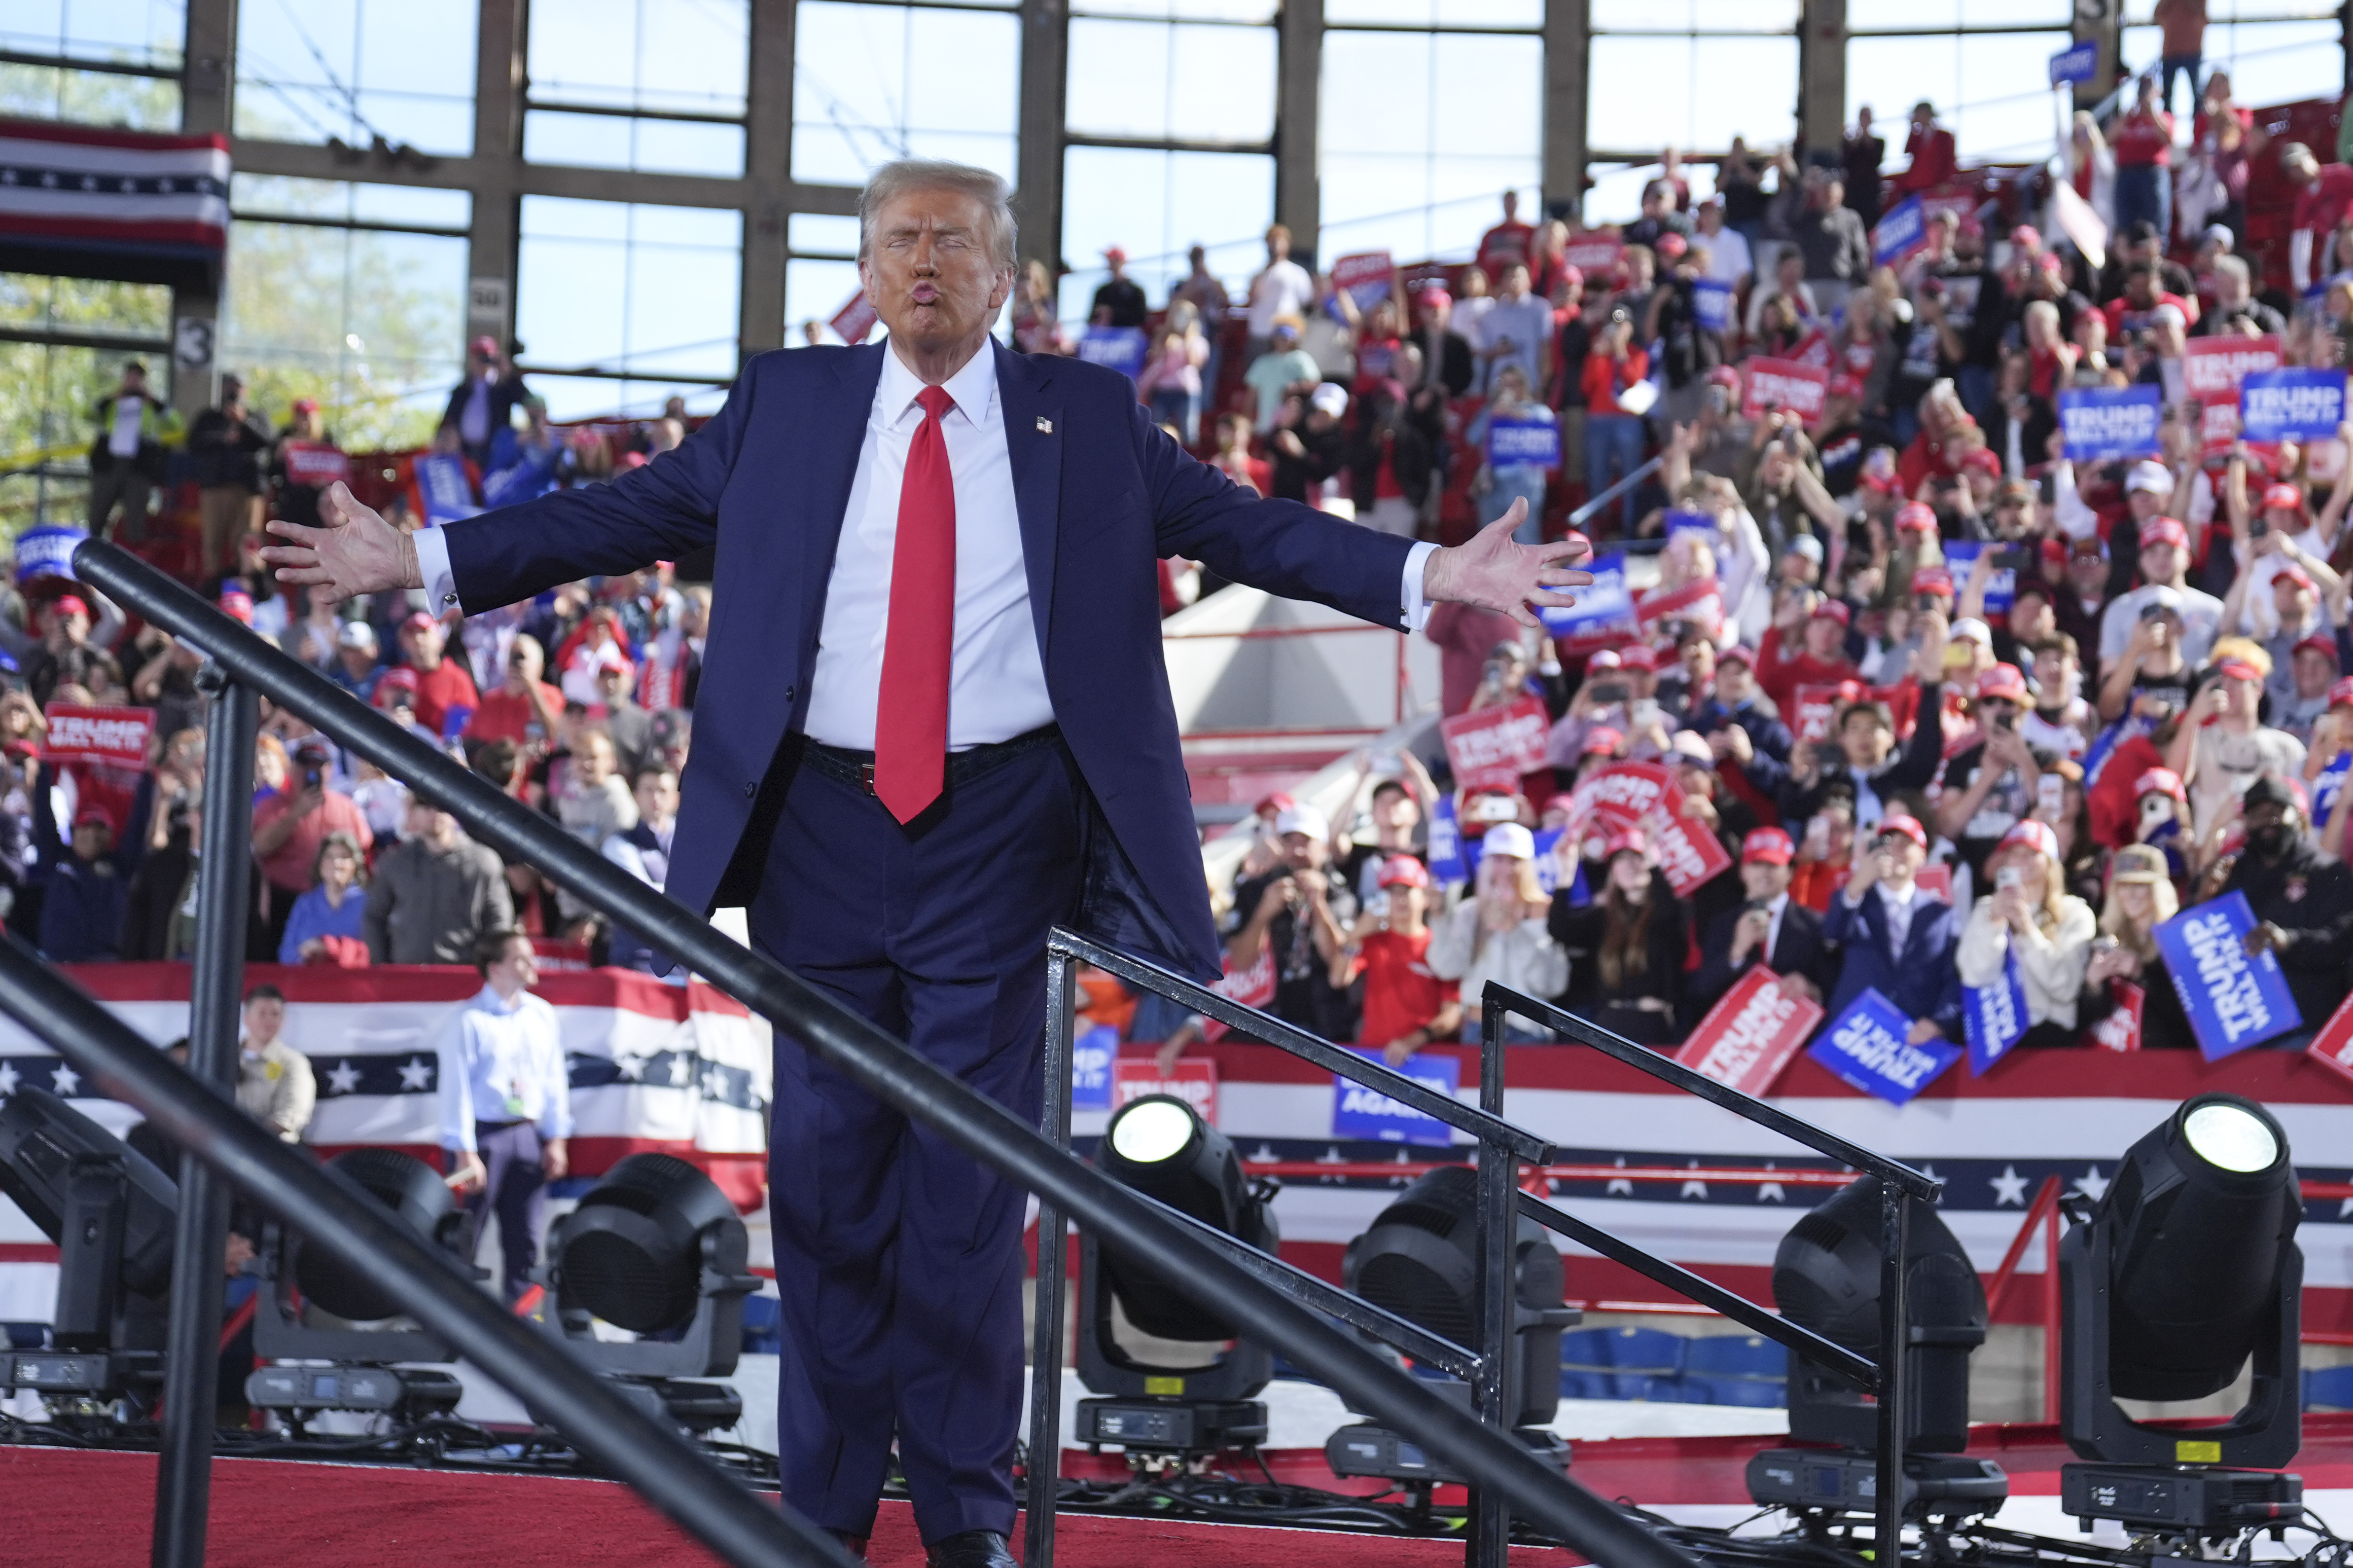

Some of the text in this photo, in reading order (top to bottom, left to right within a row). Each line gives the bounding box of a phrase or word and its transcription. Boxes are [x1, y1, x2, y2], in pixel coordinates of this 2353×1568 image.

[183, 323, 210, 366] 3
[2063, 404, 2154, 427] TRUMP
[2247, 387, 2342, 408] TRUMP
[49, 716, 148, 737] TRUMP
[1450, 714, 1543, 755] TRUMP
[2183, 919, 2253, 1042] TRUMP
[2206, 913, 2271, 1032] WILL FIX IT
[1695, 981, 1779, 1080] TRUMP
[1847, 1012, 1938, 1074] WILL FIX IT
[1832, 1028, 1917, 1089] TRUMP
